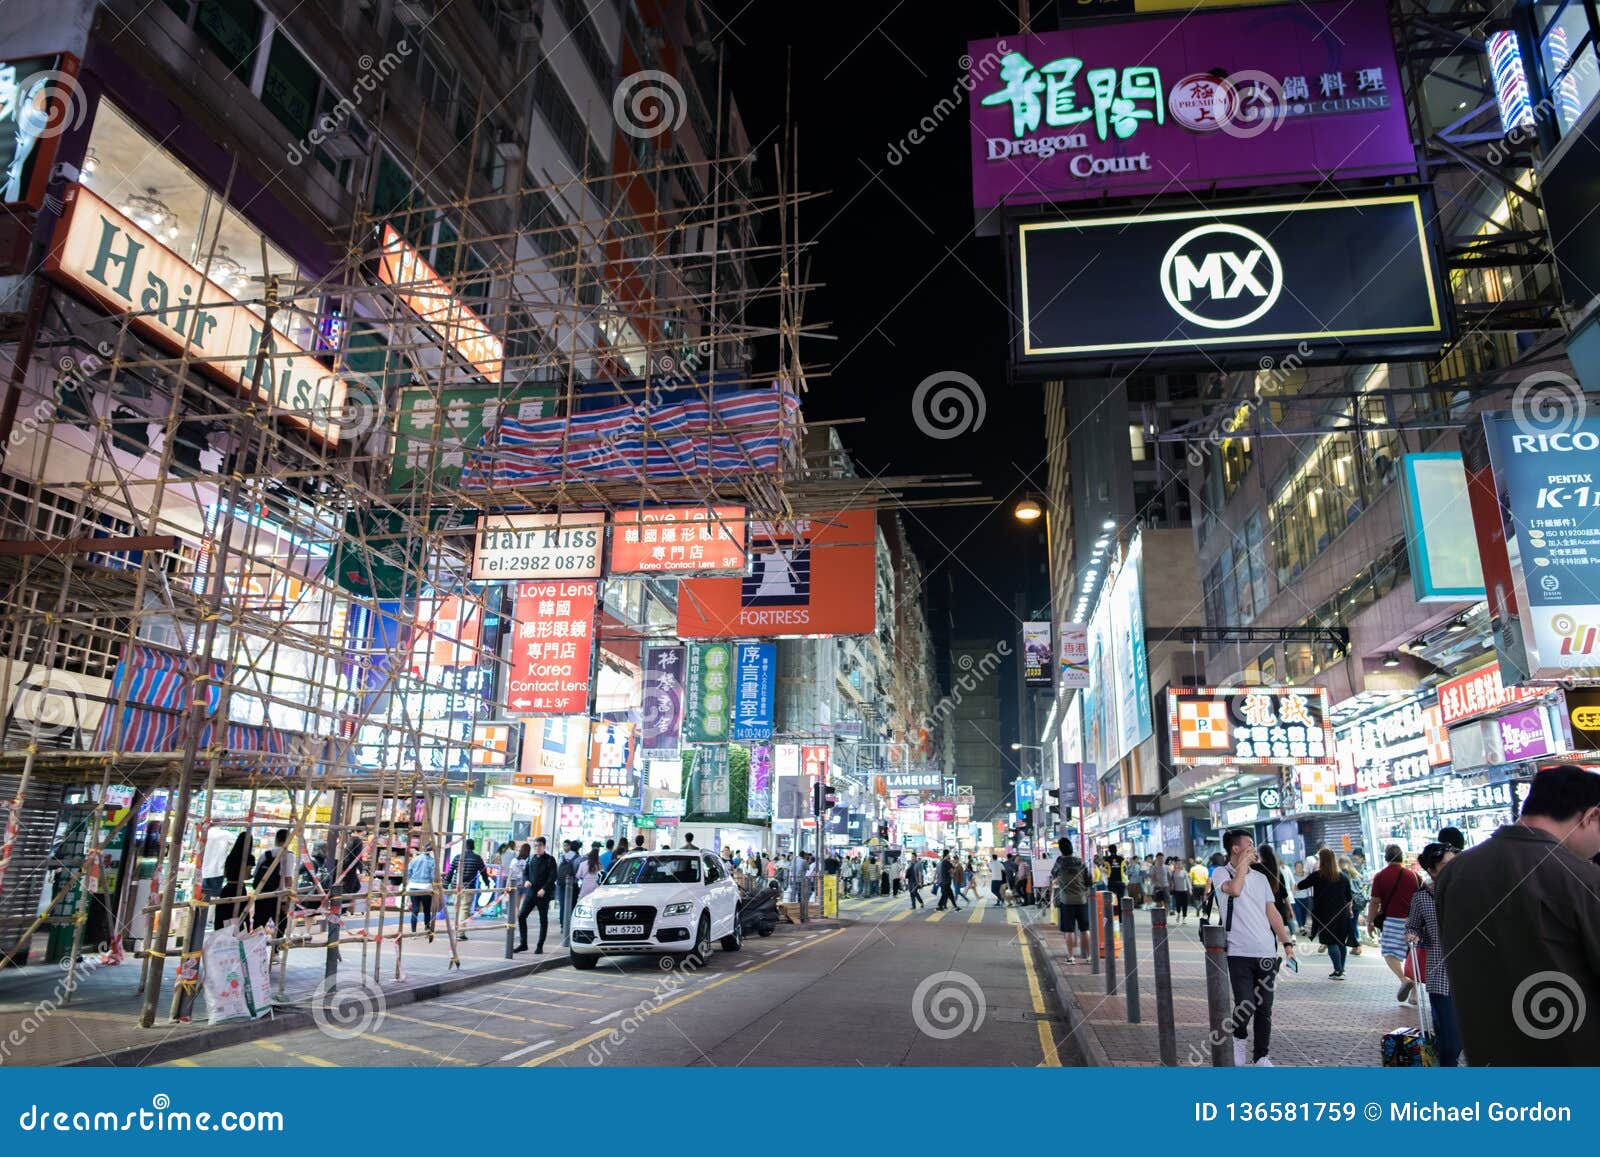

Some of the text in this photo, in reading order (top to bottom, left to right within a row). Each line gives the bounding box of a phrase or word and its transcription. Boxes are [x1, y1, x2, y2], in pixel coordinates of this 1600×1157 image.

[1247, 67, 1387, 104] 火鍋料理
[1321, 95, 1389, 113] CUISINE
[986, 132, 1088, 160] Dragon
[1069, 151, 1152, 178] Court
[86, 214, 217, 349] Hair
[1174, 249, 1269, 302] MX
[1548, 474, 1593, 484] PENTAX
[1536, 486, 1590, 509] K-1
[634, 510, 677, 527] Love
[480, 523, 597, 550] Hair Kiss
[479, 555, 596, 571] Tel:2982 0878
[639, 557, 739, 570] Korea Contact Lens 3/F
[520, 582, 595, 598] Love Lens
[538, 599, 572, 617] 韓國
[739, 609, 811, 626] FORTRESS
[527, 662, 572, 677] Korea
[510, 679, 588, 692] Contact Lens
[739, 646, 761, 717] 序言書室
[554, 698, 571, 708] 3/F
[886, 775, 940, 786] LANEIGE
